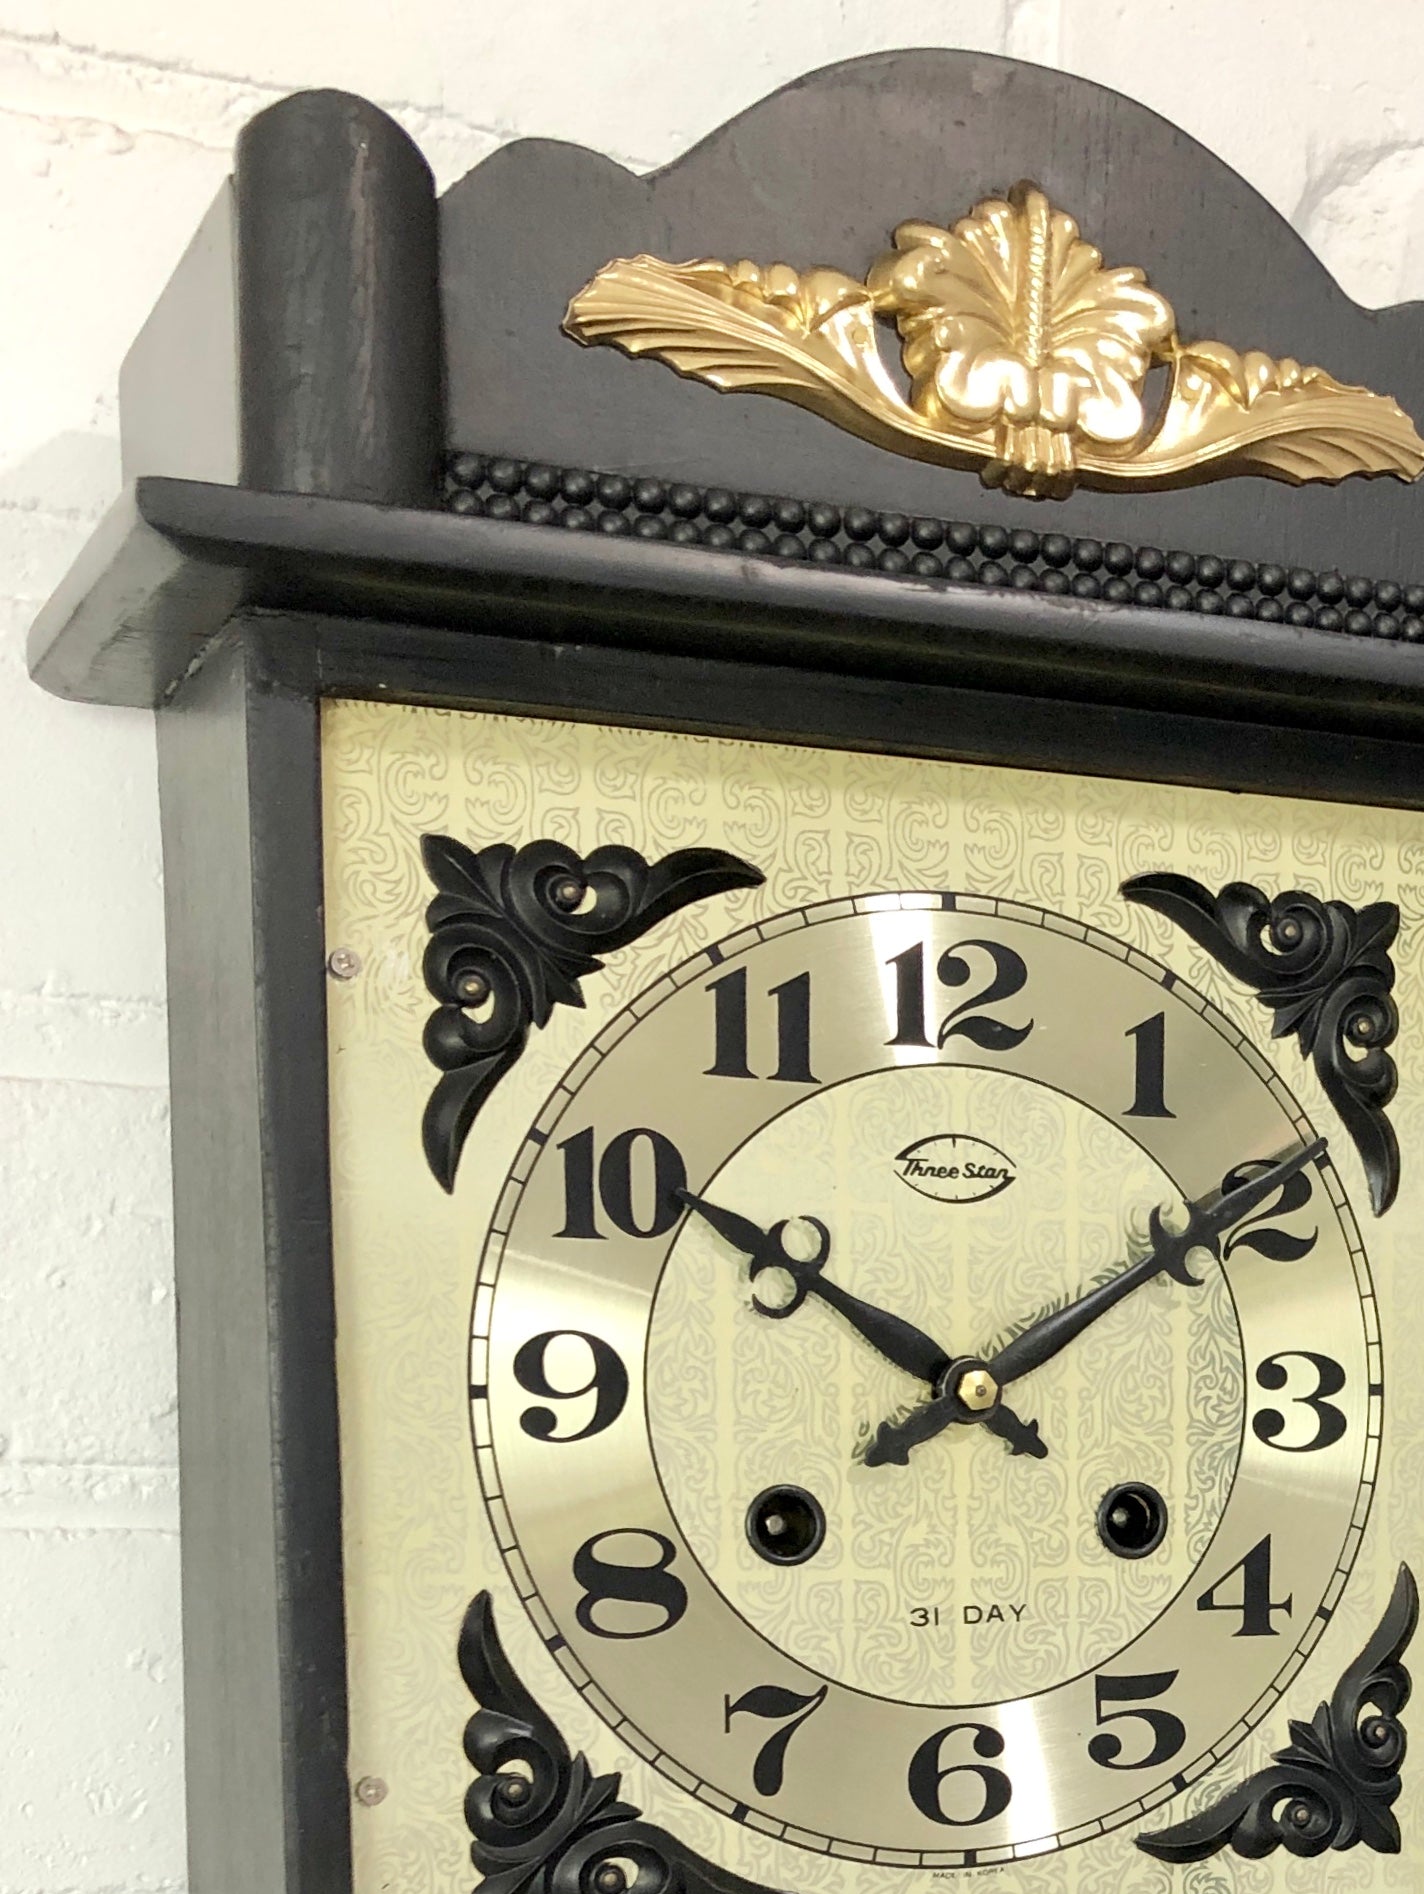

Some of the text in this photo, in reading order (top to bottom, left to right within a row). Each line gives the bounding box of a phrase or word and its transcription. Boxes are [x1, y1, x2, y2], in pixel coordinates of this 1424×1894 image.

[702, 965, 823, 1085] 11
[884, 939, 1035, 1051] 12
[1121, 1011, 1177, 1119] 1
[551, 1125, 688, 1240] 10
[901, 1157, 1010, 1180] Three Star
[1221, 1159, 1319, 1263] 2
[513, 1330, 629, 1443] 9
[1252, 1350, 1347, 1453] 3
[572, 1527, 689, 1640] 8
[909, 1603, 1027, 1628] 31 DAY
[1196, 1533, 1293, 1637] 4
[724, 1684, 829, 1797] 7
[1087, 1669, 1187, 1771] 5
[907, 1722, 1012, 1827] 6
